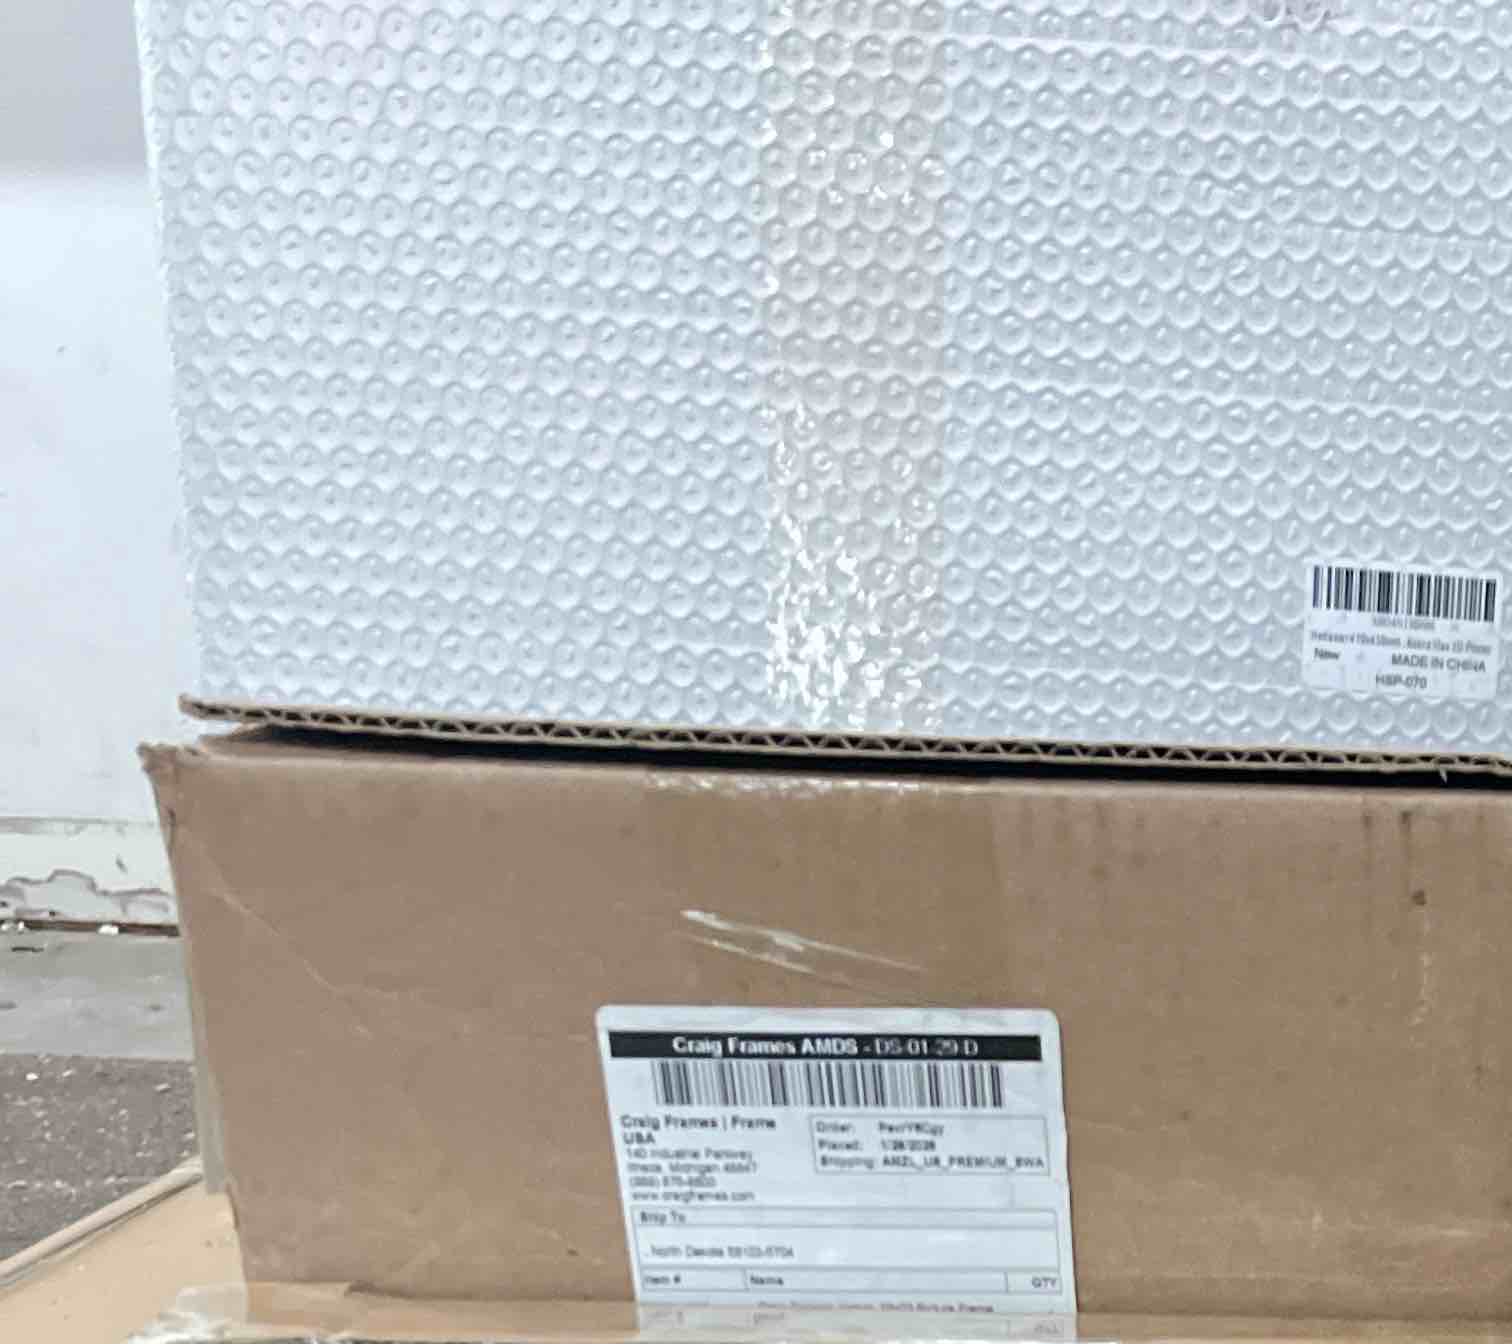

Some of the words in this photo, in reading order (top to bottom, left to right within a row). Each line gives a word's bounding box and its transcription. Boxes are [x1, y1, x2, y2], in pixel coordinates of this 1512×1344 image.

[1391, 654, 1428, 669] MADE
[1430, 656, 1445, 669] IN
[1446, 658, 1486, 673] CHINA
[672, 1036, 723, 1057] Craig
[728, 1037, 797, 1055] Frames
[801, 1038, 859, 1055] AMDS
[620, 1115, 661, 1131] Craig
[664, 1116, 719, 1129] Frames
[731, 1116, 777, 1129] Frame
[623, 1132, 656, 1145] USA
[1031, 1277, 1058, 1288] QTY
